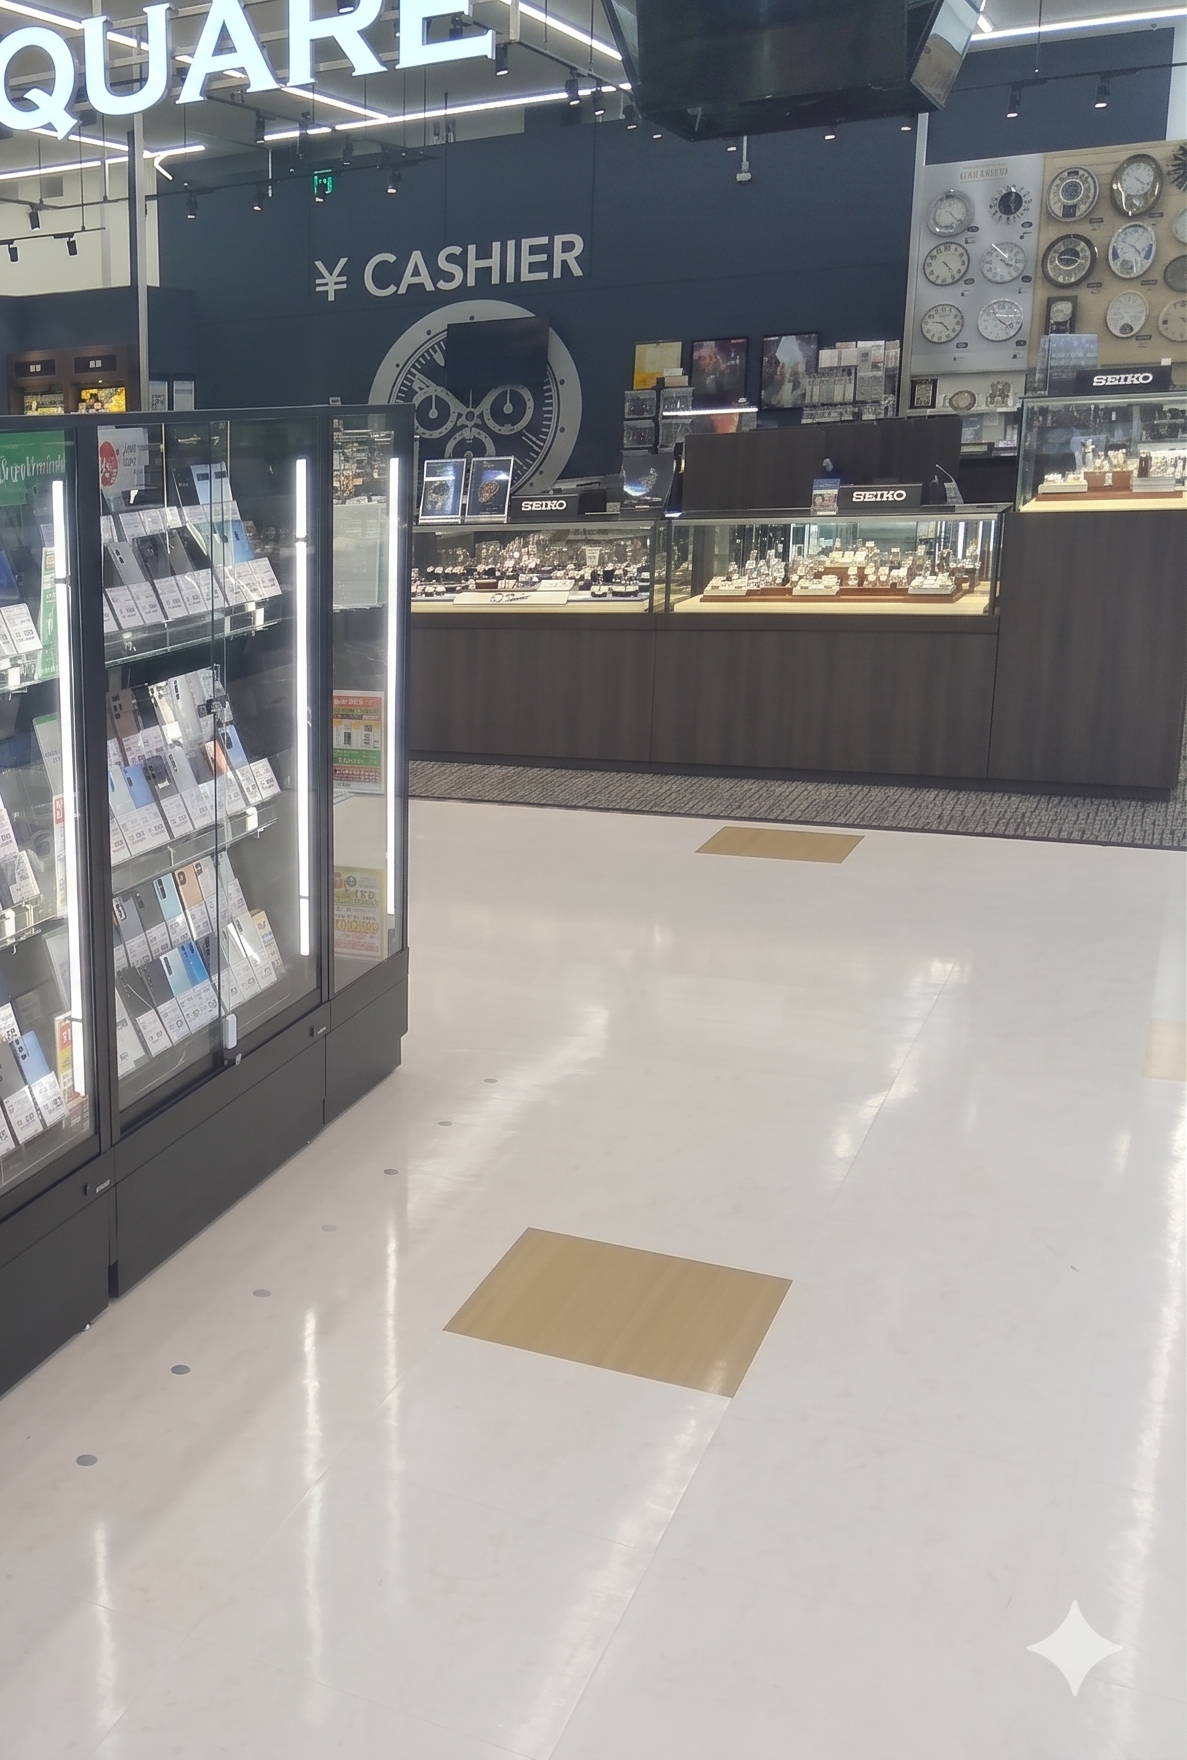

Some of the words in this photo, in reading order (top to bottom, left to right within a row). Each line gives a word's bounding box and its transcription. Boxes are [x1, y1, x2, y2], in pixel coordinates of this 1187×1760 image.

[364, 233, 584, 297] CASHIER
[1093, 373, 1153, 386] SEIKO
[852, 490, 907, 502] SEIKO
[521, 500, 567, 511] SEIKO
